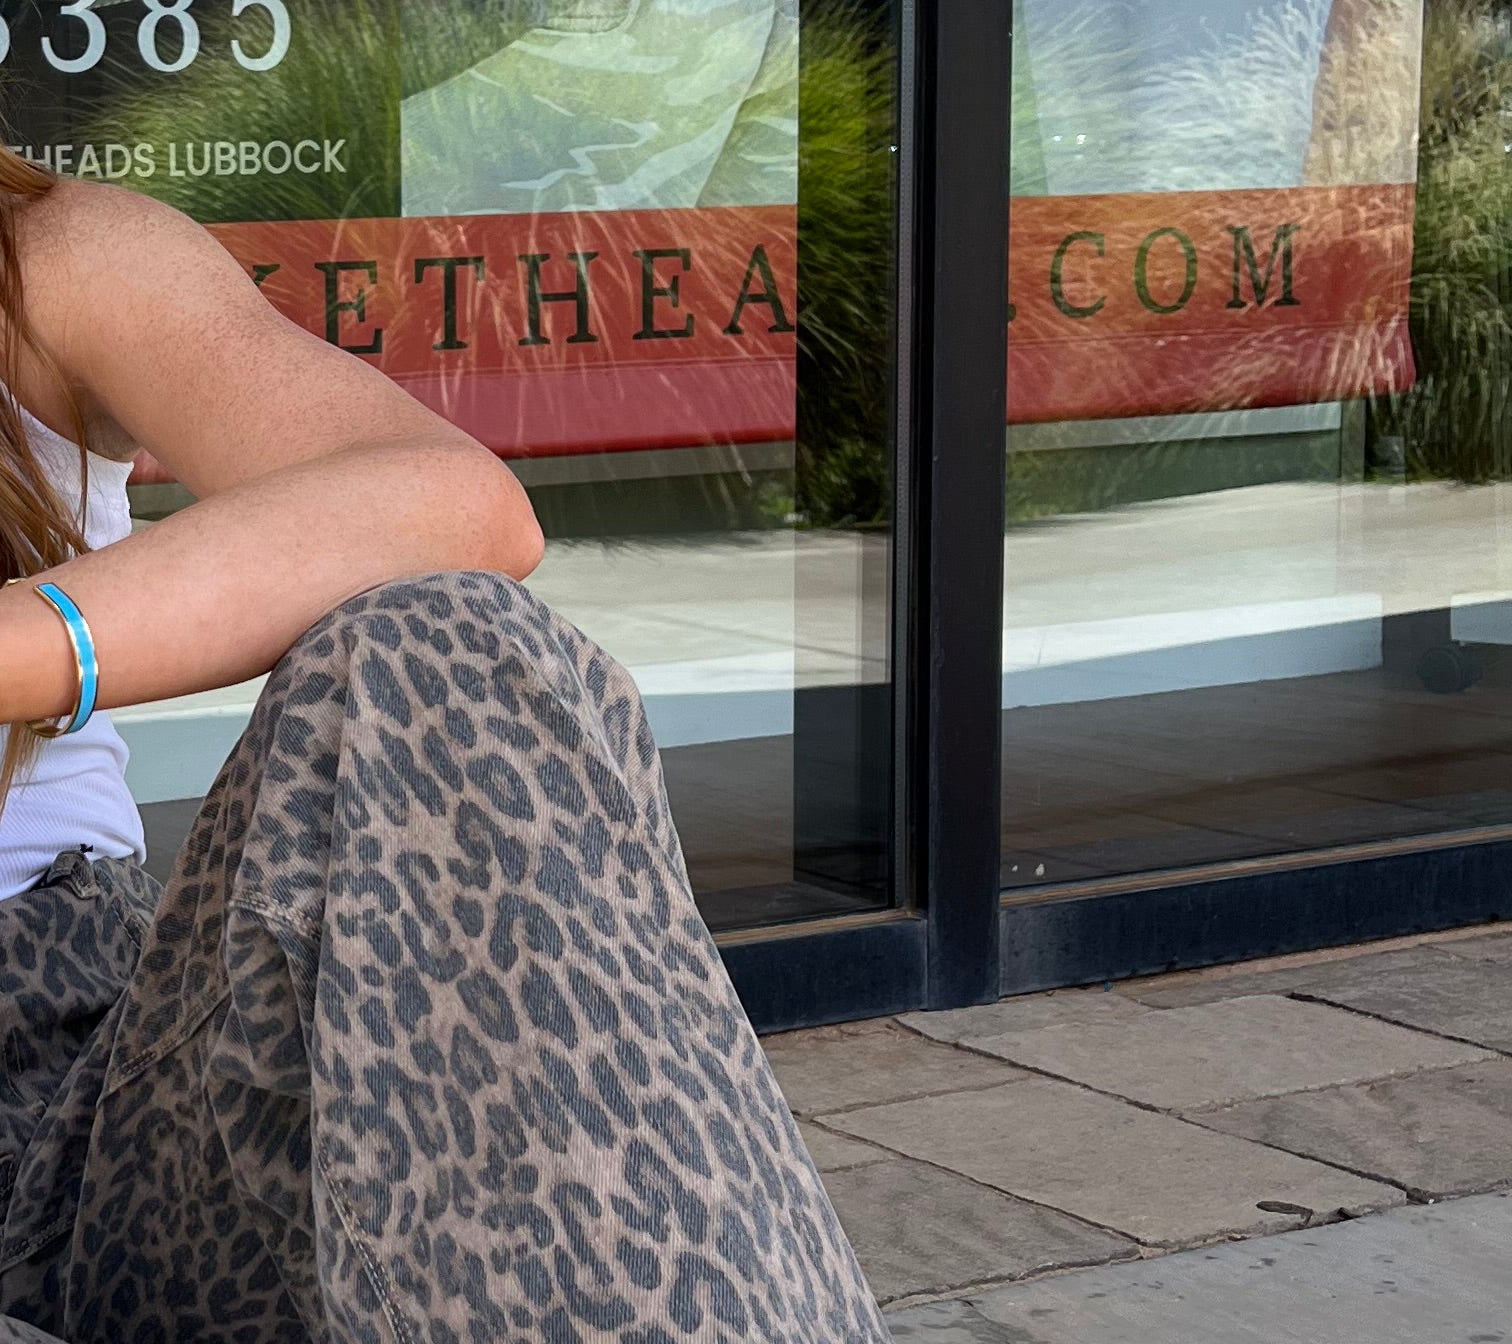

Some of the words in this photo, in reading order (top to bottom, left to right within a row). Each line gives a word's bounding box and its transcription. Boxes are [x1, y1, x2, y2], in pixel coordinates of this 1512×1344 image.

[6, 142, 157, 179] HEADS
[169, 139, 347, 177] LUBBOCK
[252, 242, 796, 355] ETHEA
